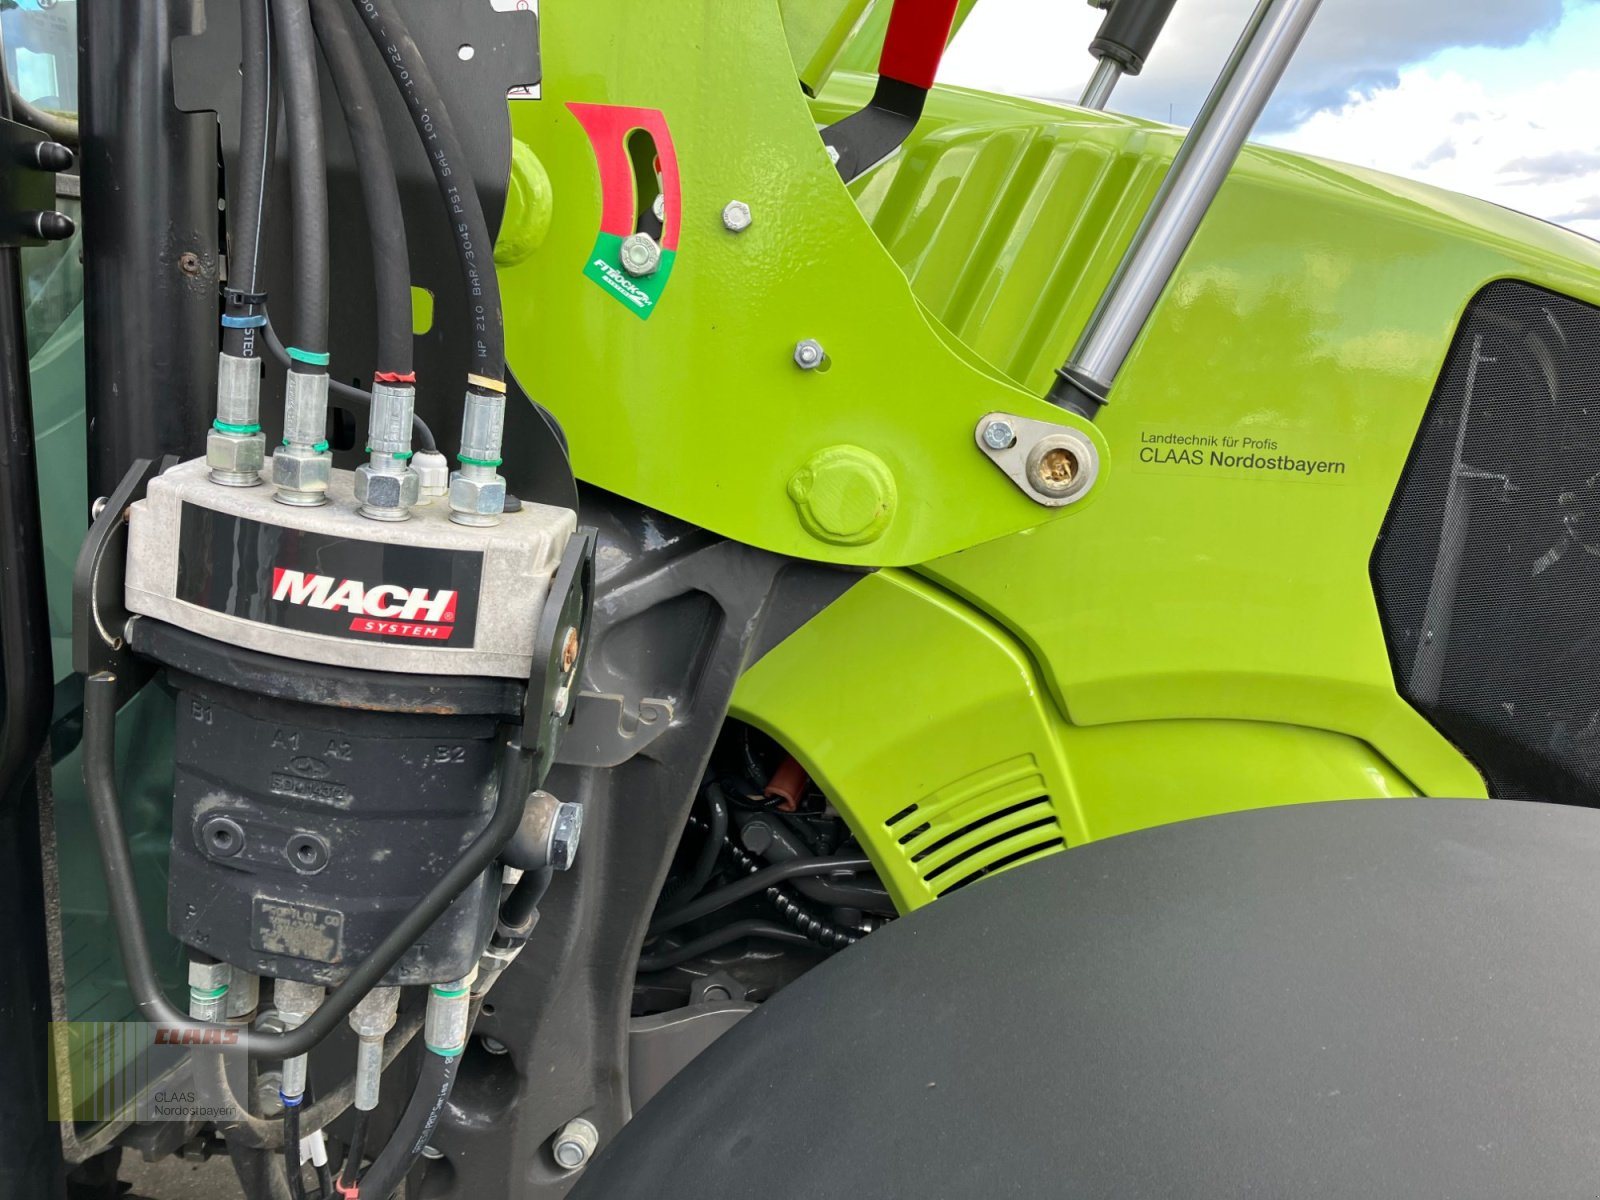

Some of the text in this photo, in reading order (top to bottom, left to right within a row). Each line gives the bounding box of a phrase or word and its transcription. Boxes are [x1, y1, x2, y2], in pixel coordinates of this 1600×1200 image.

[434, 150, 452, 177] SAE
[447, 186, 464, 214] PSI
[459, 223, 482, 296] BAR/3045
[475, 305, 486, 332] 210
[477, 341, 487, 358] WP
[1140, 431, 1278, 451] Landtechnik für Profis
[1139, 446, 1346, 476] CLAAS Nordostbayern
[363, 620, 440, 638] SYSTEM
